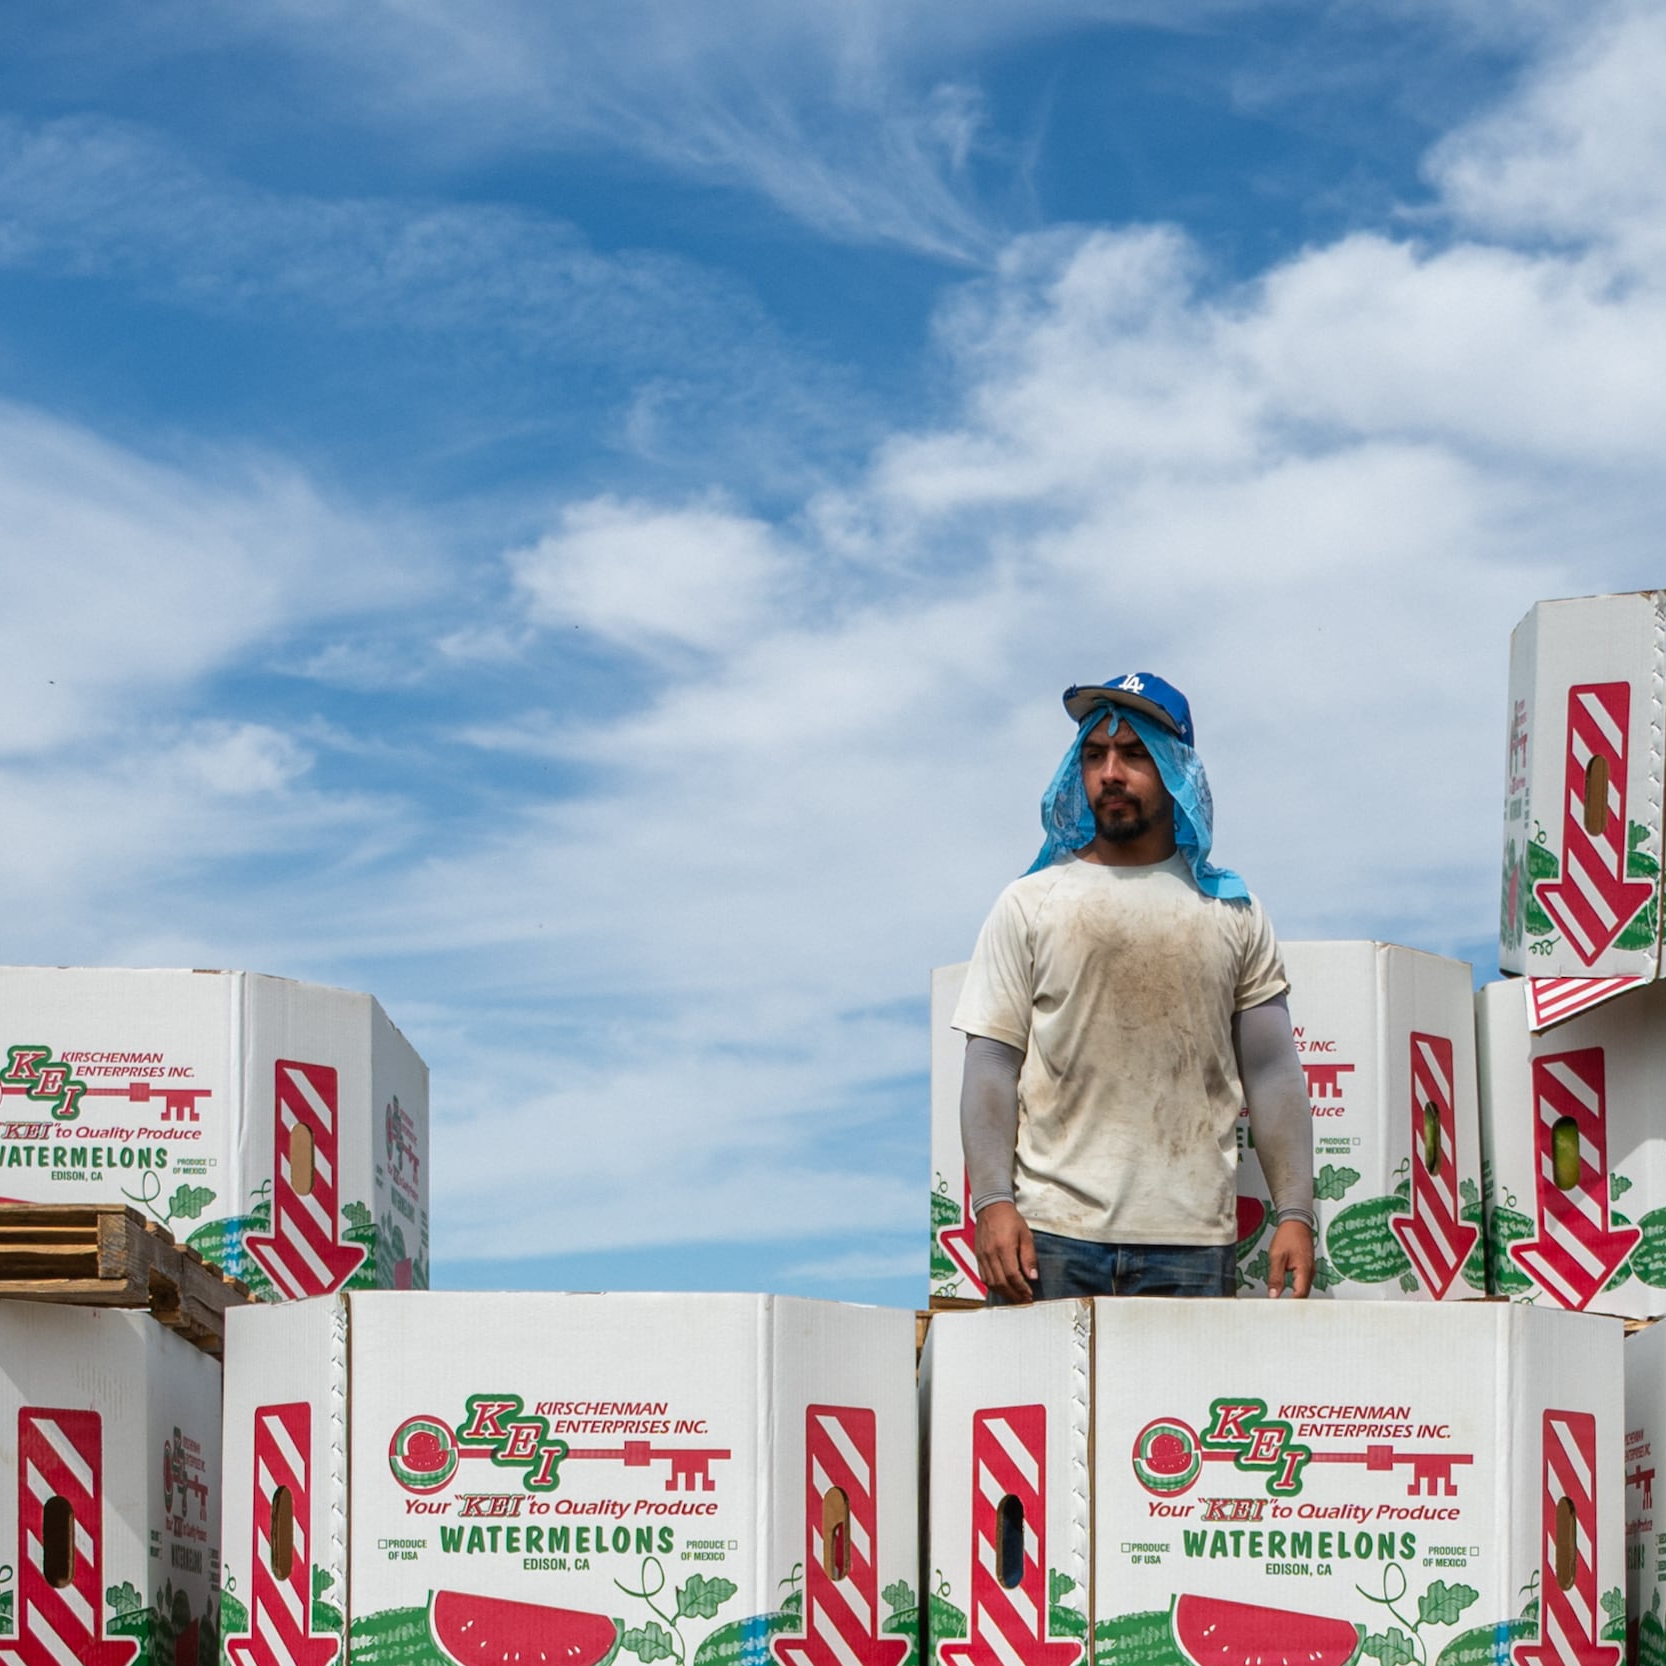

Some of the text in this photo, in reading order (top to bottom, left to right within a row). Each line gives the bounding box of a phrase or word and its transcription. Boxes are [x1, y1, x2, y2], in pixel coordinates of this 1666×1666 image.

[1118, 674, 1145, 694] LA
[60, 1052, 164, 1064] KIRSCHENMAN
[76, 1065, 195, 1078] ENTERPRISES INC.
[4, 1049, 83, 1118] KEI
[51, 1171, 103, 1182] EDISON, CA
[534, 1401, 668, 1417] KIRSCHENMAN
[1278, 1405, 1411, 1420] KIRSCHENMAN
[555, 1419, 709, 1435] ENTERPRISES INC.
[1298, 1423, 1452, 1439] ENTERPRISES INC.
[461, 1399, 564, 1488] KEI
[1205, 1402, 1307, 1492] KEI
[1147, 1502, 1194, 1519] Your
[1273, 1504, 1292, 1519] to
[1297, 1504, 1374, 1525] Quality
[1376, 1504, 1461, 1521] Produce
[439, 1524, 675, 1556] WATERMELONS
[1182, 1529, 1417, 1560] WATERMELONS
[1132, 1543, 1170, 1553] PRODUCE
[1428, 1546, 1468, 1556] PRODUCE
[523, 1558, 591, 1572] EDISON, CA
[1131, 1555, 1162, 1565] OF USA
[1422, 1558, 1467, 1568] OF MEXICO
[1265, 1563, 1333, 1577] EDISON, CA
